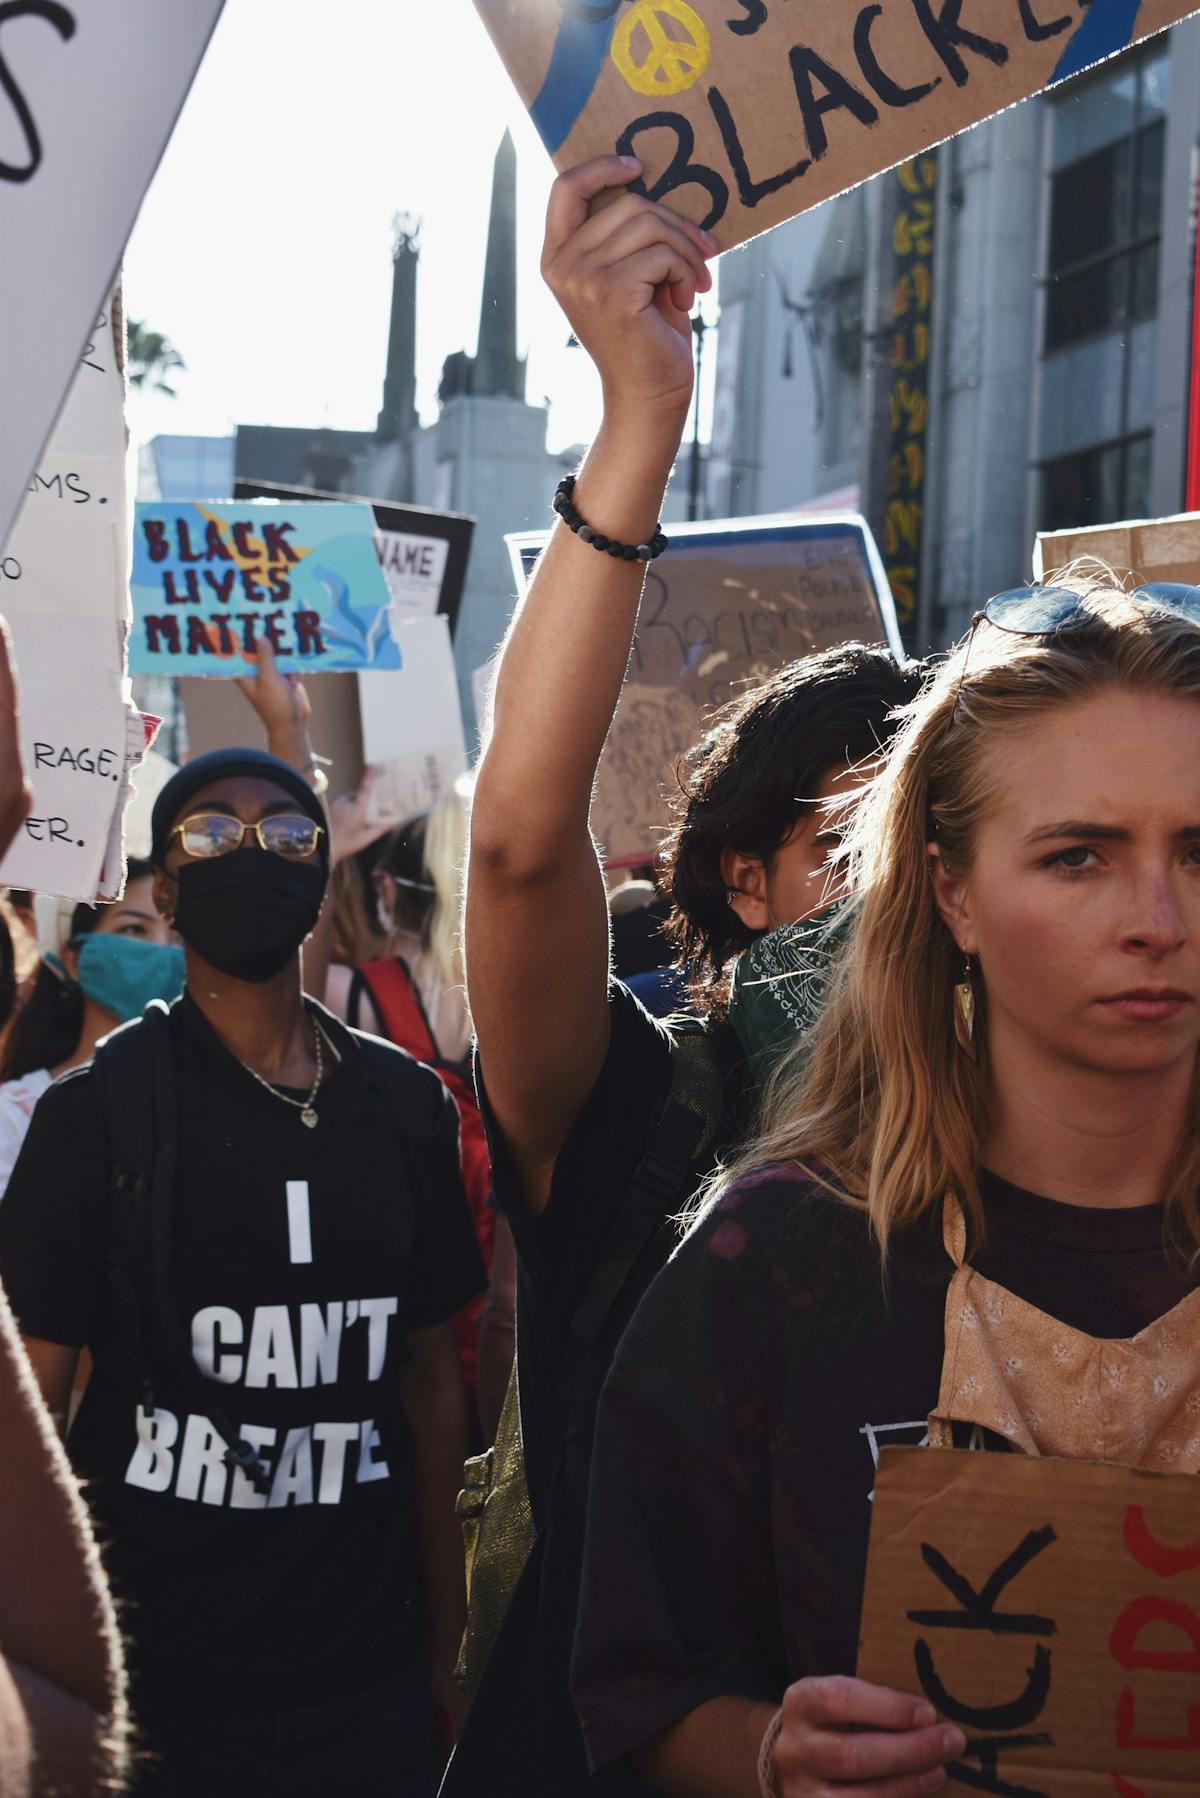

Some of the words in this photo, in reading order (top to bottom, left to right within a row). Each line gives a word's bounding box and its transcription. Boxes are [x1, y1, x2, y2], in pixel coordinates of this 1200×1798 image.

[615, 0, 1010, 232] BLACK
[142, 517, 301, 564] BLACK
[163, 565, 292, 605] LIVES
[143, 609, 328, 655] MATTER
[286, 1180, 313, 1264] I
[191, 1297, 399, 1389] CAN'T
